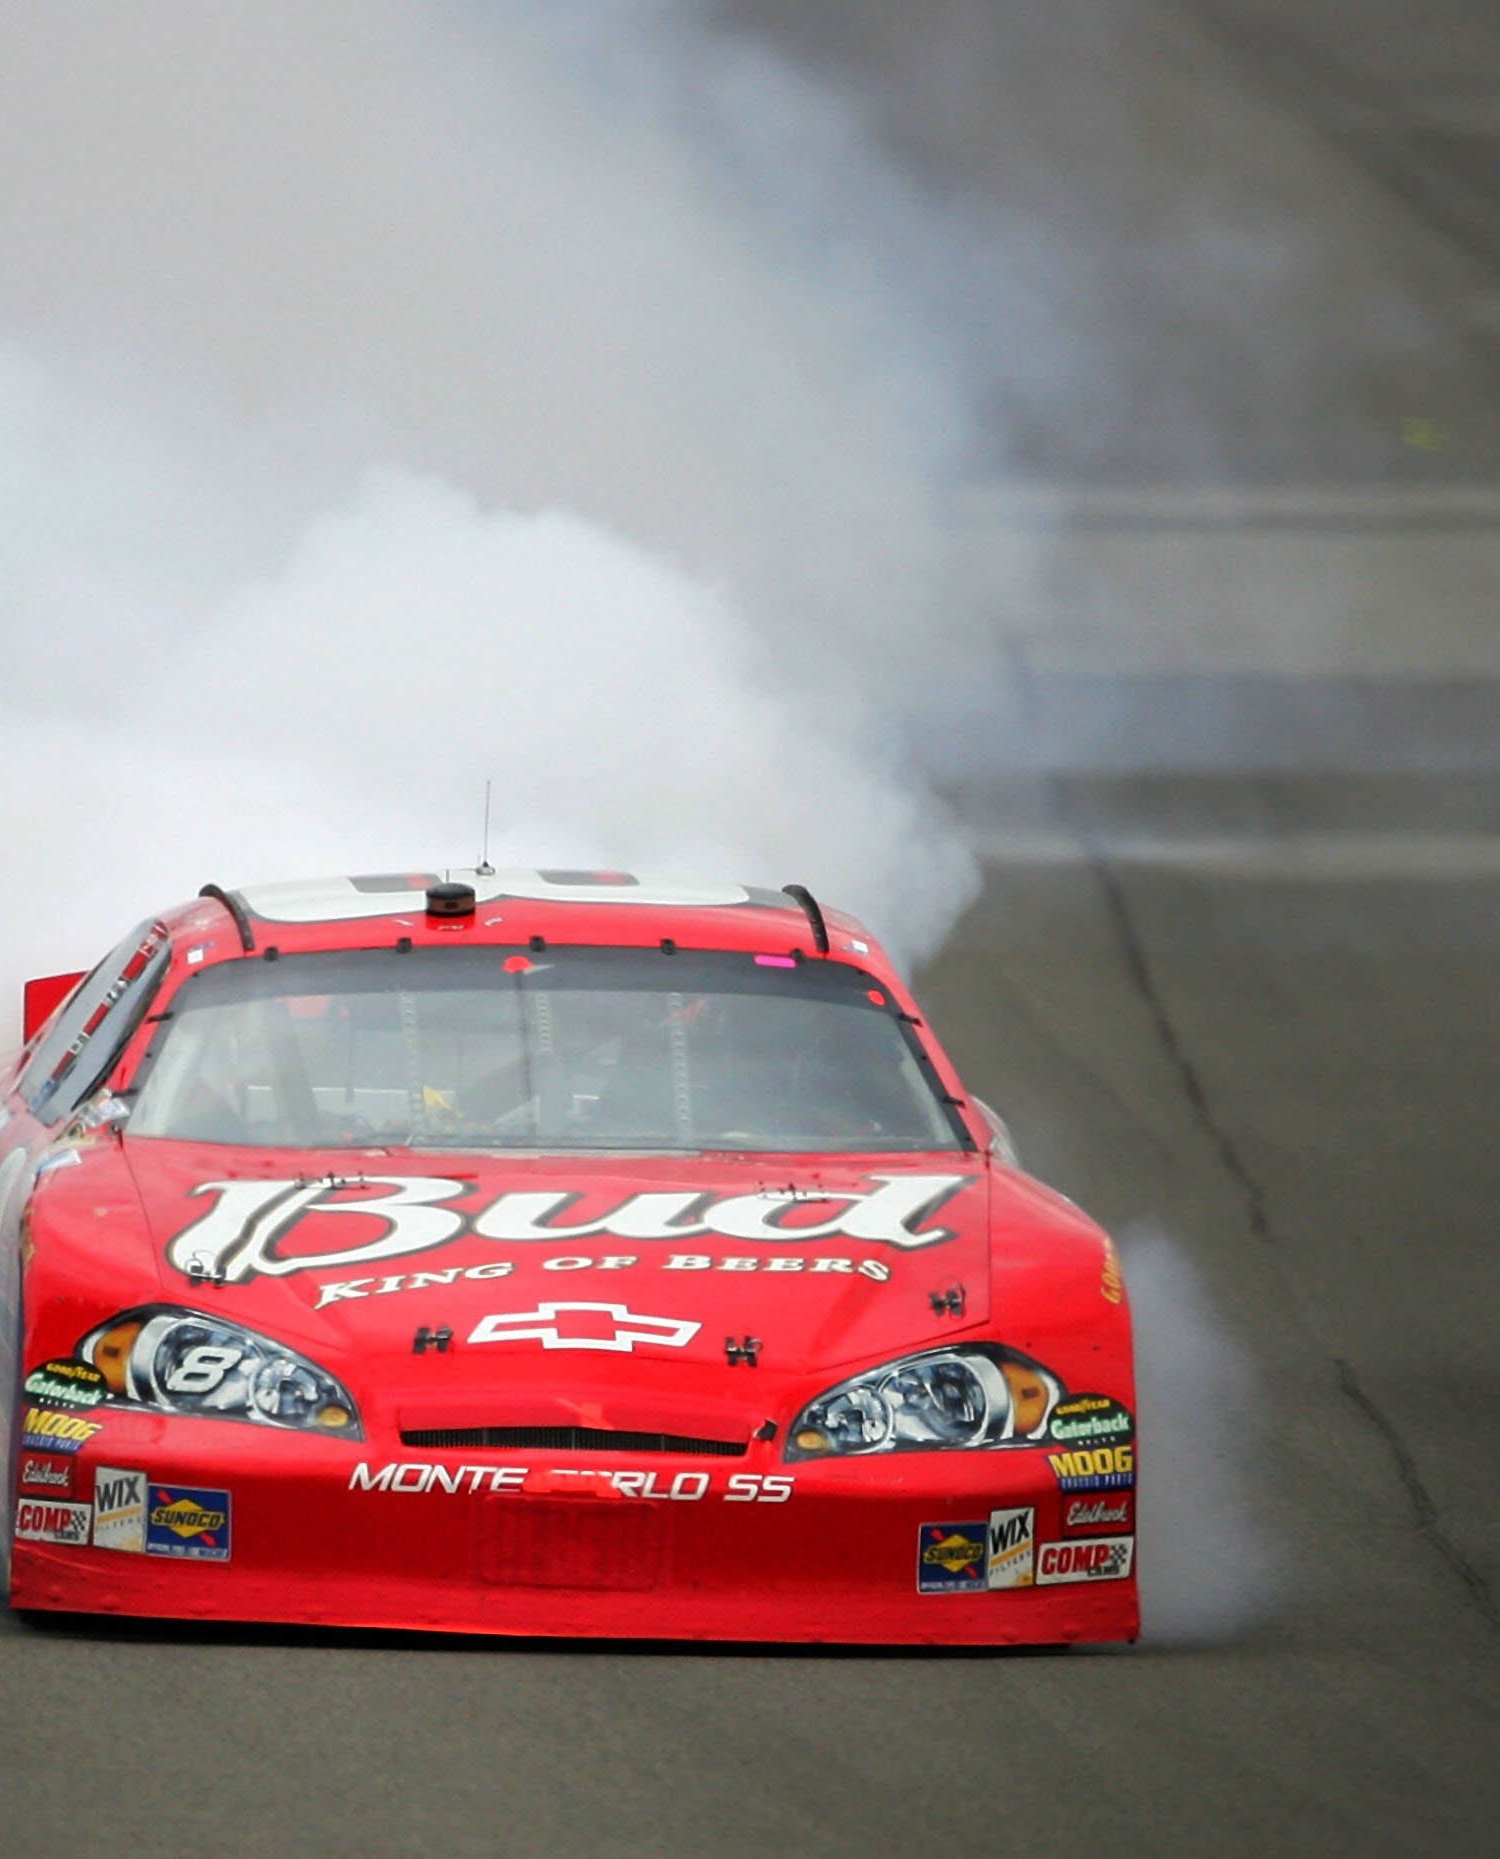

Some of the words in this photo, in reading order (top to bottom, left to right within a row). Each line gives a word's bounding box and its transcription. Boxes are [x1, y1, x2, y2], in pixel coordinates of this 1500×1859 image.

[167, 1172, 968, 1282] Bud
[314, 1262, 514, 1310] KING
[542, 1256, 637, 1272] OF
[662, 1254, 889, 1281] BEERS
[166, 1345, 244, 1393] 8
[24, 1408, 103, 1441] MOOG
[1051, 1412, 1129, 1440] Gatorback
[1048, 1446, 1132, 1477] MOOG
[95, 1476, 141, 1513] WIX
[348, 1463, 529, 1494] MONTE
[550, 1469, 708, 1501] RLO
[723, 1474, 795, 1503] SS
[20, 1505, 72, 1532] COMP
[153, 1509, 222, 1529] SUNOCO
[991, 1510, 1031, 1555] WIX
[925, 1546, 982, 1563] SUNOCO
[1042, 1544, 1110, 1575] COMP
